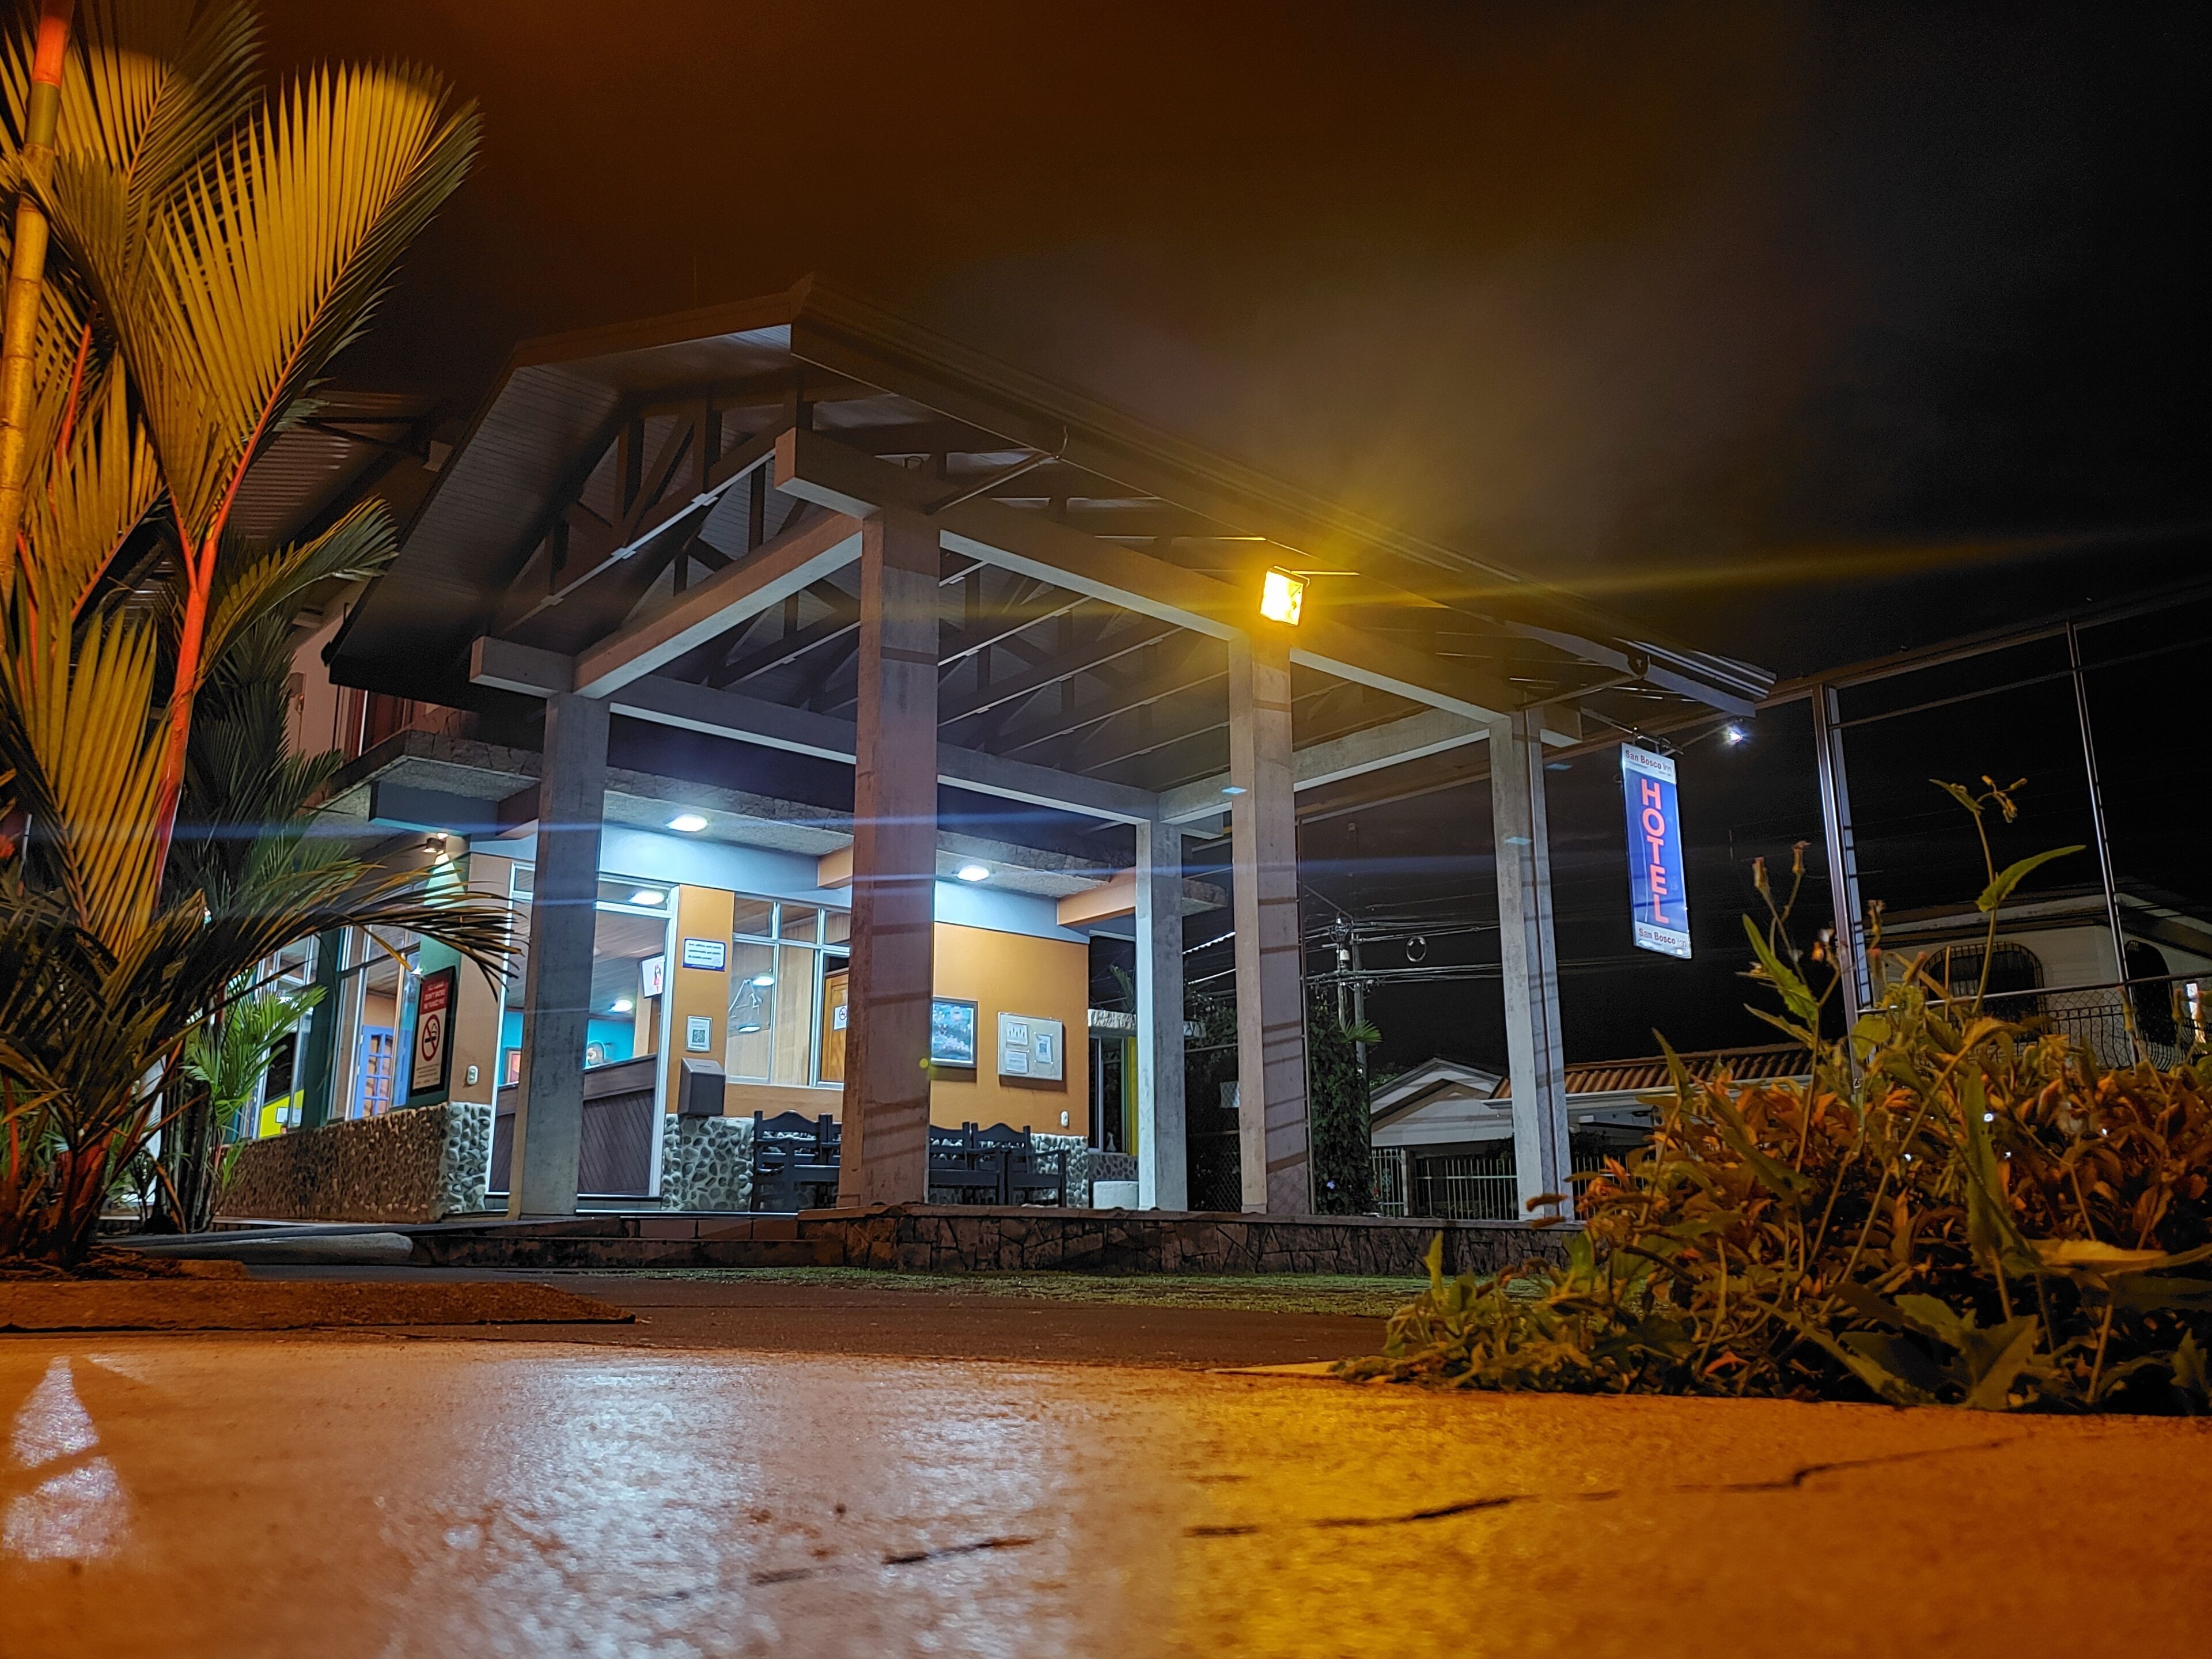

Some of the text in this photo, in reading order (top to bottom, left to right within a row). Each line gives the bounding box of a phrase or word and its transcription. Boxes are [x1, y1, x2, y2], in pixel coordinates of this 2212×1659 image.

[1625, 749, 1639, 762] San
[1640, 755, 1661, 770] Bosco
[1641, 778, 1669, 924] HOTEL
[1639, 928, 1653, 939] San
[1654, 931, 1676, 945] Bosco
